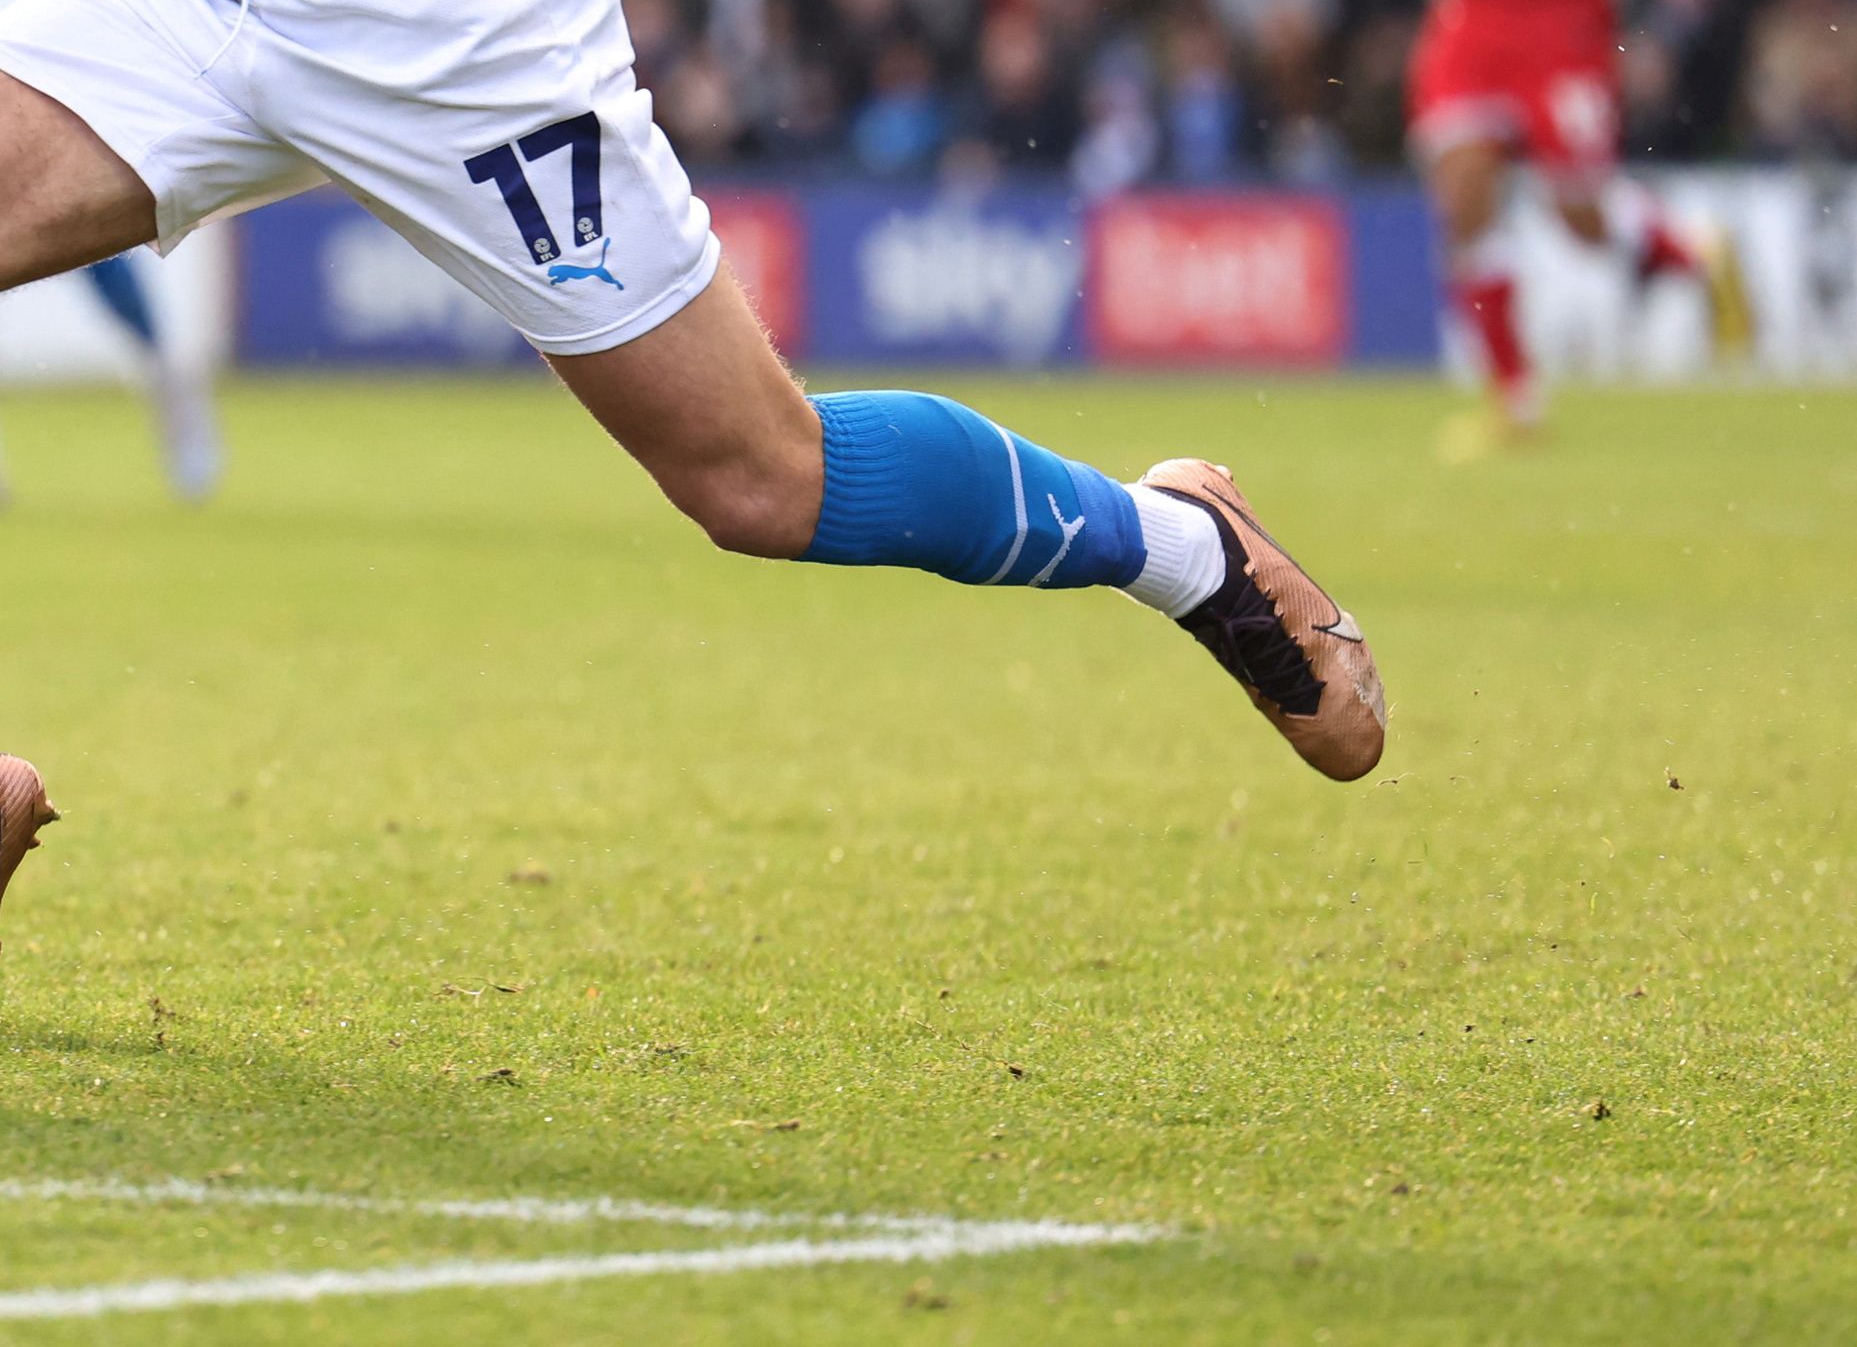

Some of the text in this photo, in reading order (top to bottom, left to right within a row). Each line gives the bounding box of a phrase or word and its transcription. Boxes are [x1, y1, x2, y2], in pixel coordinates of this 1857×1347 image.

[463, 110, 602, 265] 17
[583, 231, 598, 242] EFL
[540, 251, 554, 261] EFL
